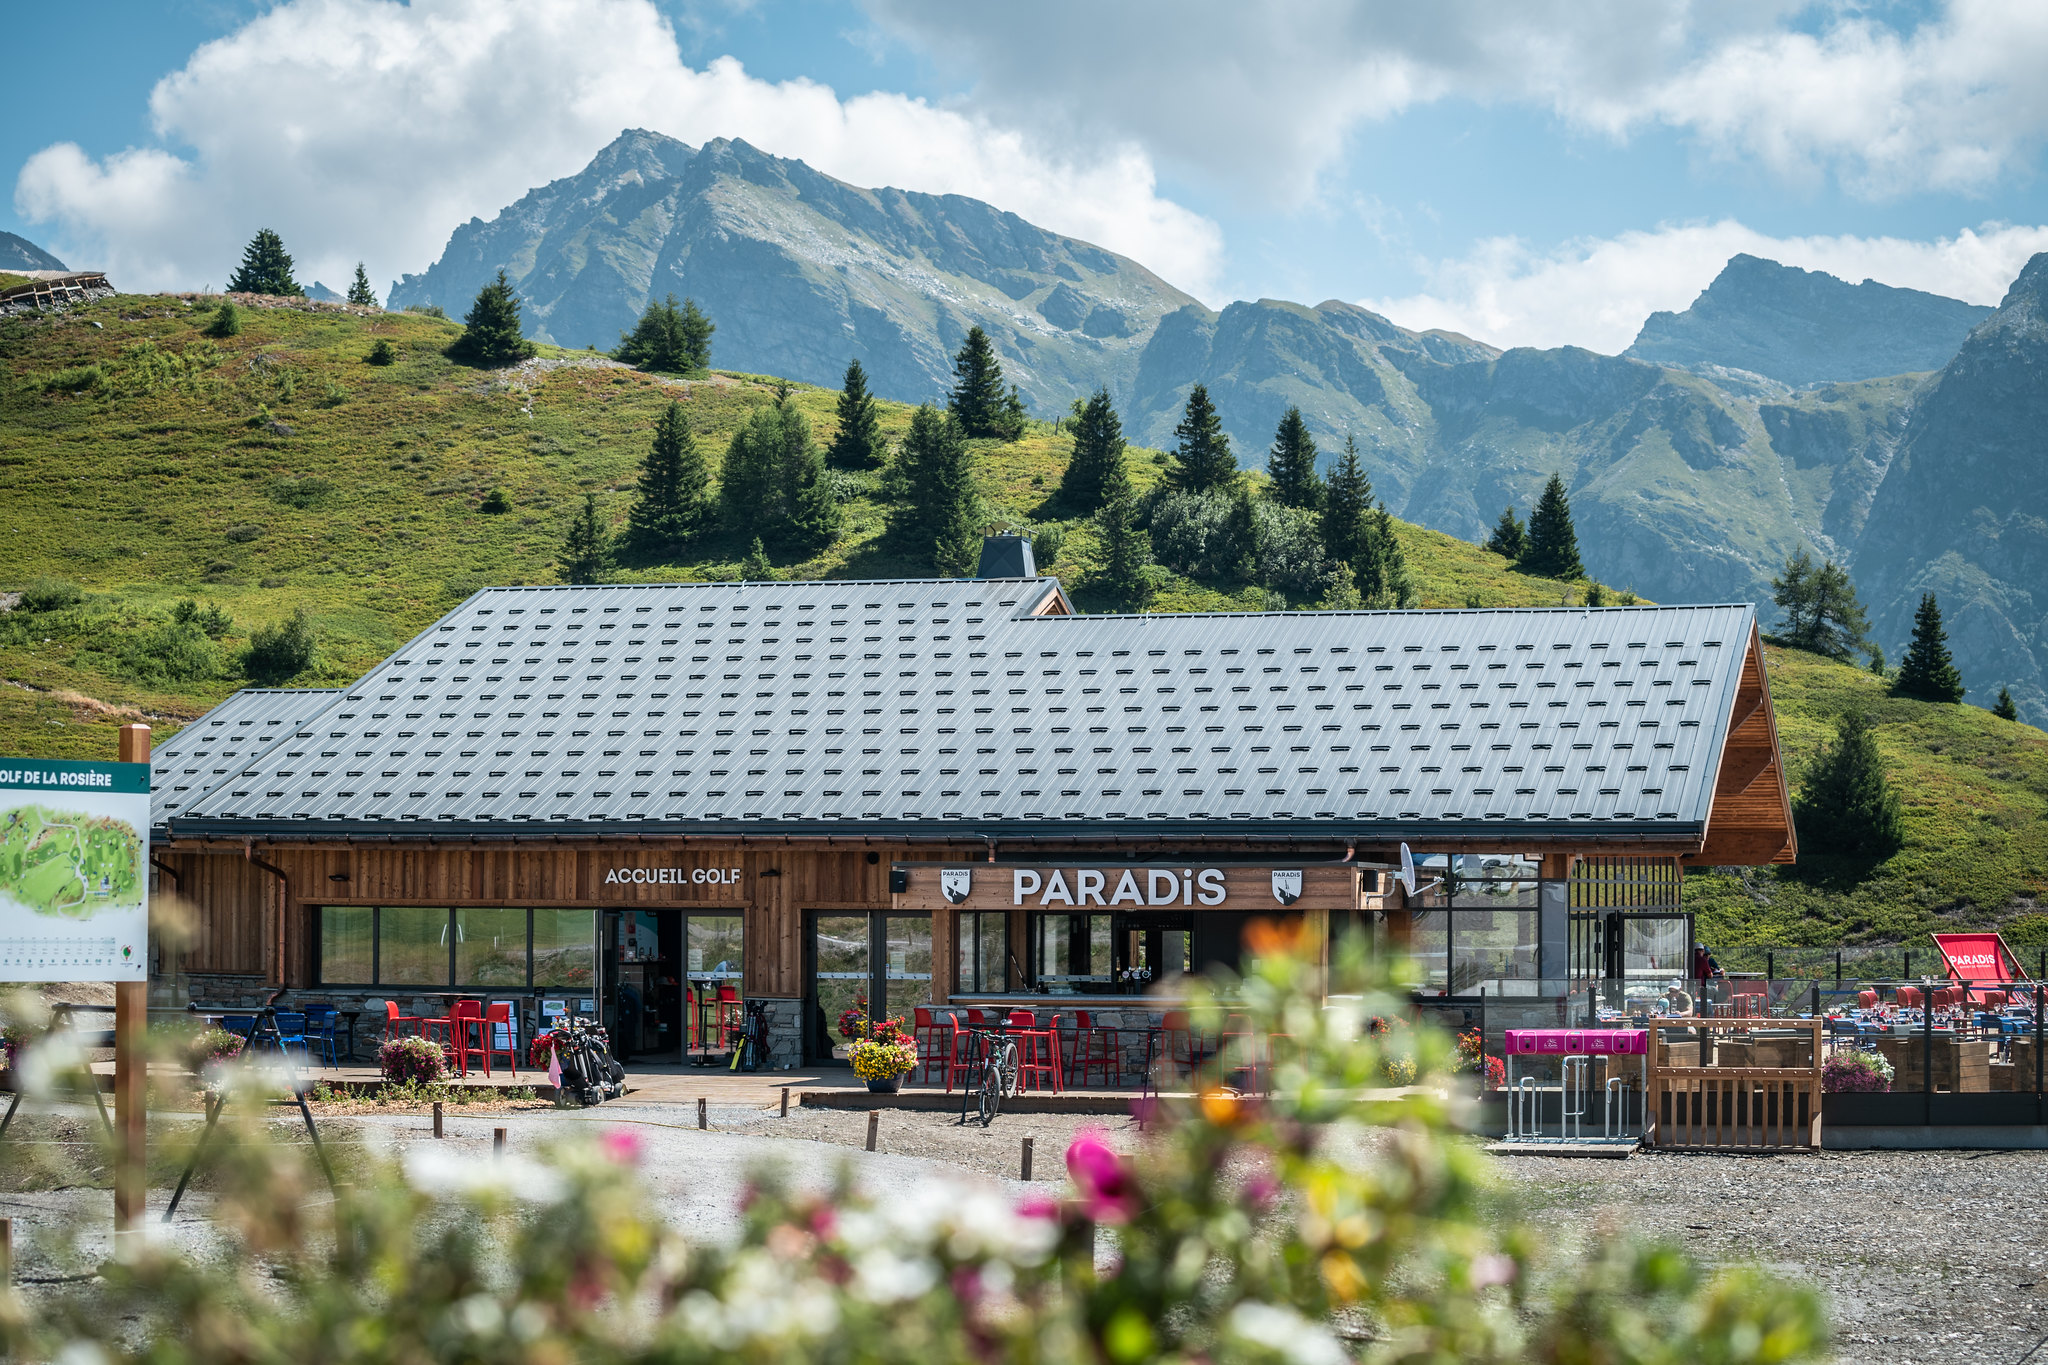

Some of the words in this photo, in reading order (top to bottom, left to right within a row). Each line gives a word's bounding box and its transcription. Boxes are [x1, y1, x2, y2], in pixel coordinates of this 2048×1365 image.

[24, 771, 40, 784] DE
[43, 772, 58, 785] LA
[60, 769, 112, 786] ROSIÈRE
[604, 868, 688, 884] ACCUEIL
[691, 868, 741, 884] GOLF
